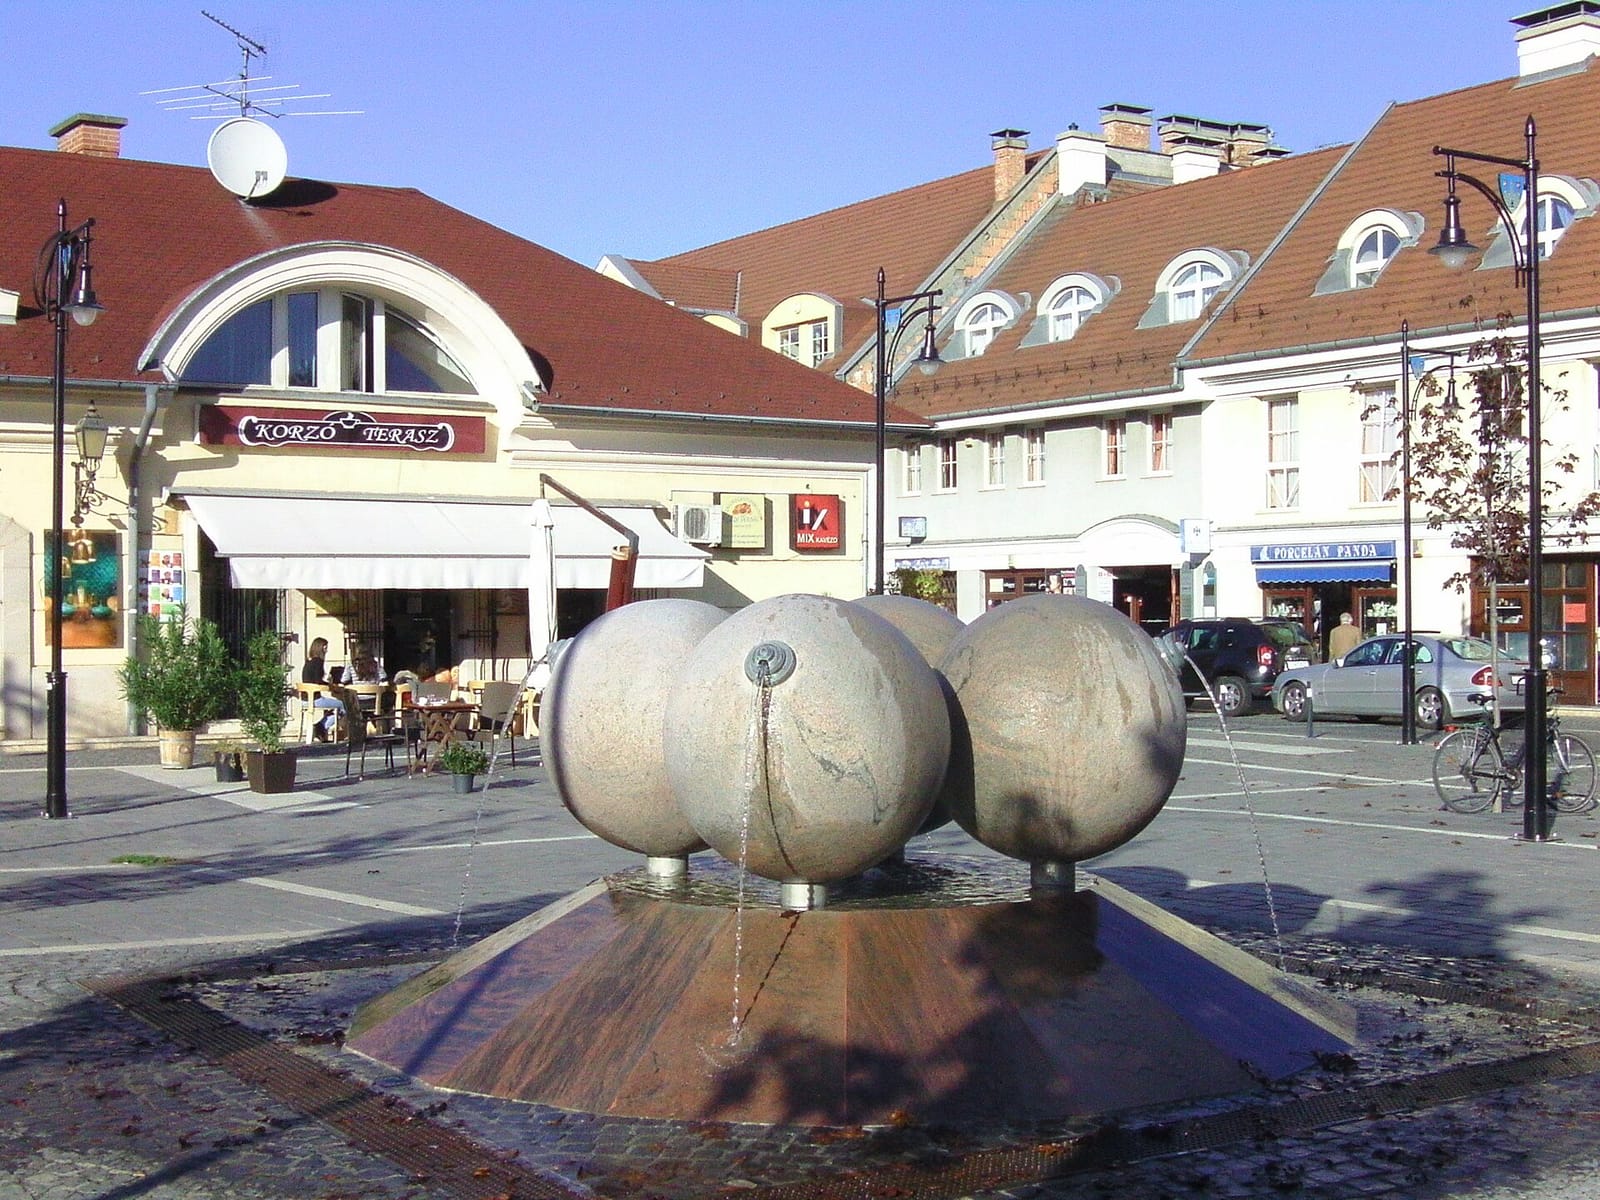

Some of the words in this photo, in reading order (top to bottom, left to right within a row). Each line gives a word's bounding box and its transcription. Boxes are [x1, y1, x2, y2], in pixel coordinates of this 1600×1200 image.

[255, 422, 336, 441] KORZÓ
[363, 427, 439, 444] TERASZ
[797, 533, 815, 544] MIX
[1337, 543, 1377, 558] PANDA
